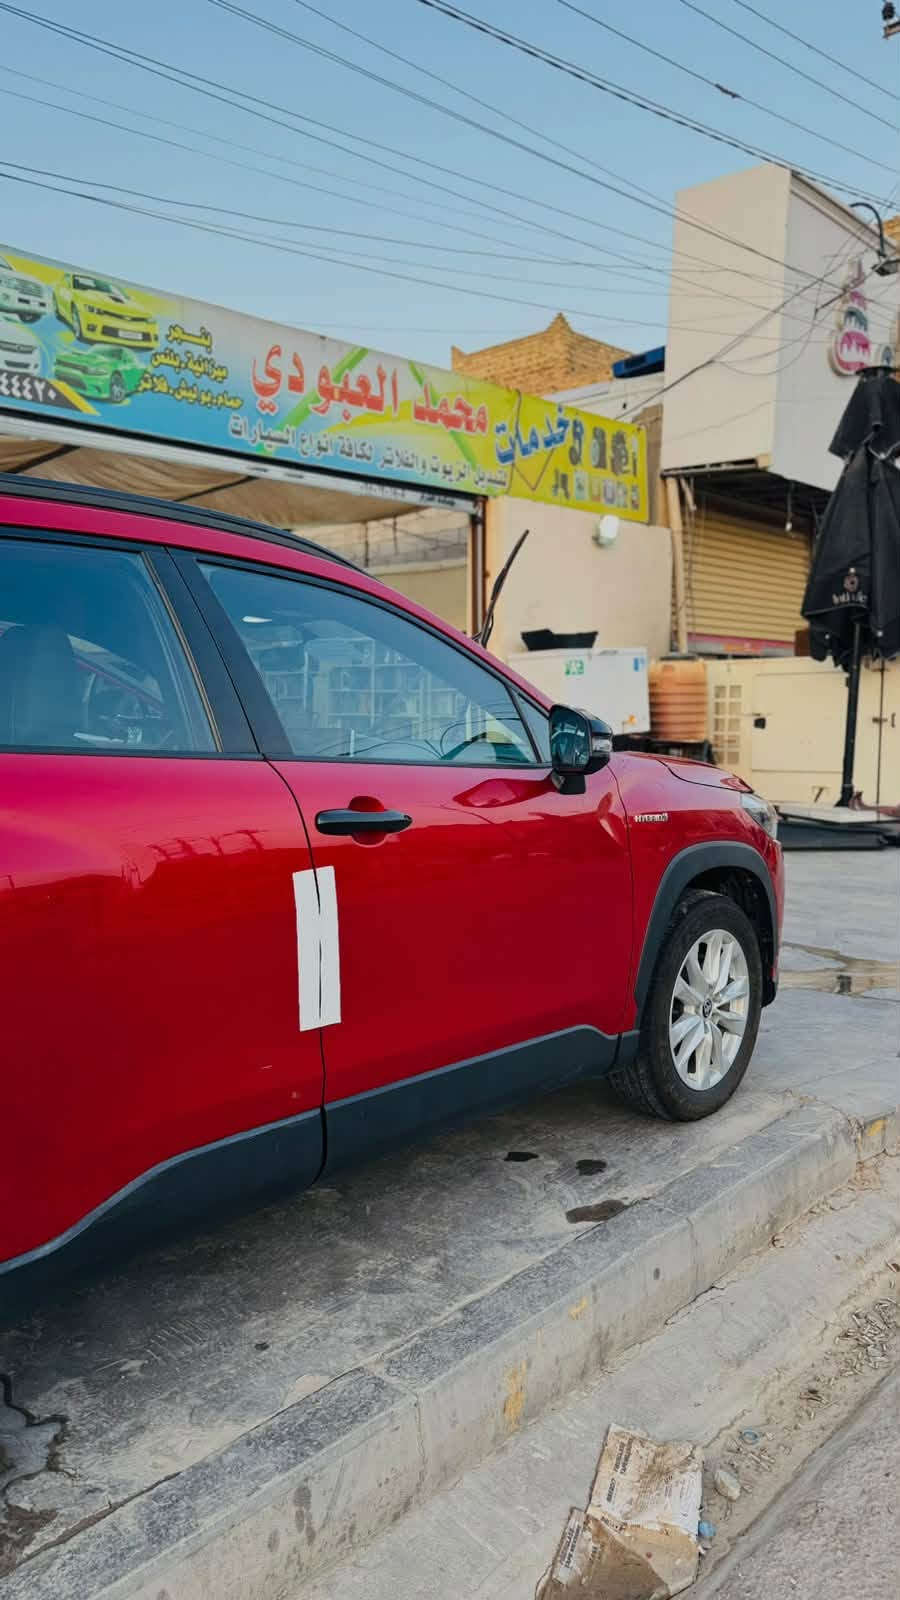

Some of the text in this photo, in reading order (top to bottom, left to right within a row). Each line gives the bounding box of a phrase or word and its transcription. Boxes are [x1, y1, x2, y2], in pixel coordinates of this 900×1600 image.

[251, 344, 572, 466] خدمات محمد العبودي
[229, 414, 296, 449] السيارات
[299, 432, 334, 457] انواع
[337, 434, 374, 461] لكافة
